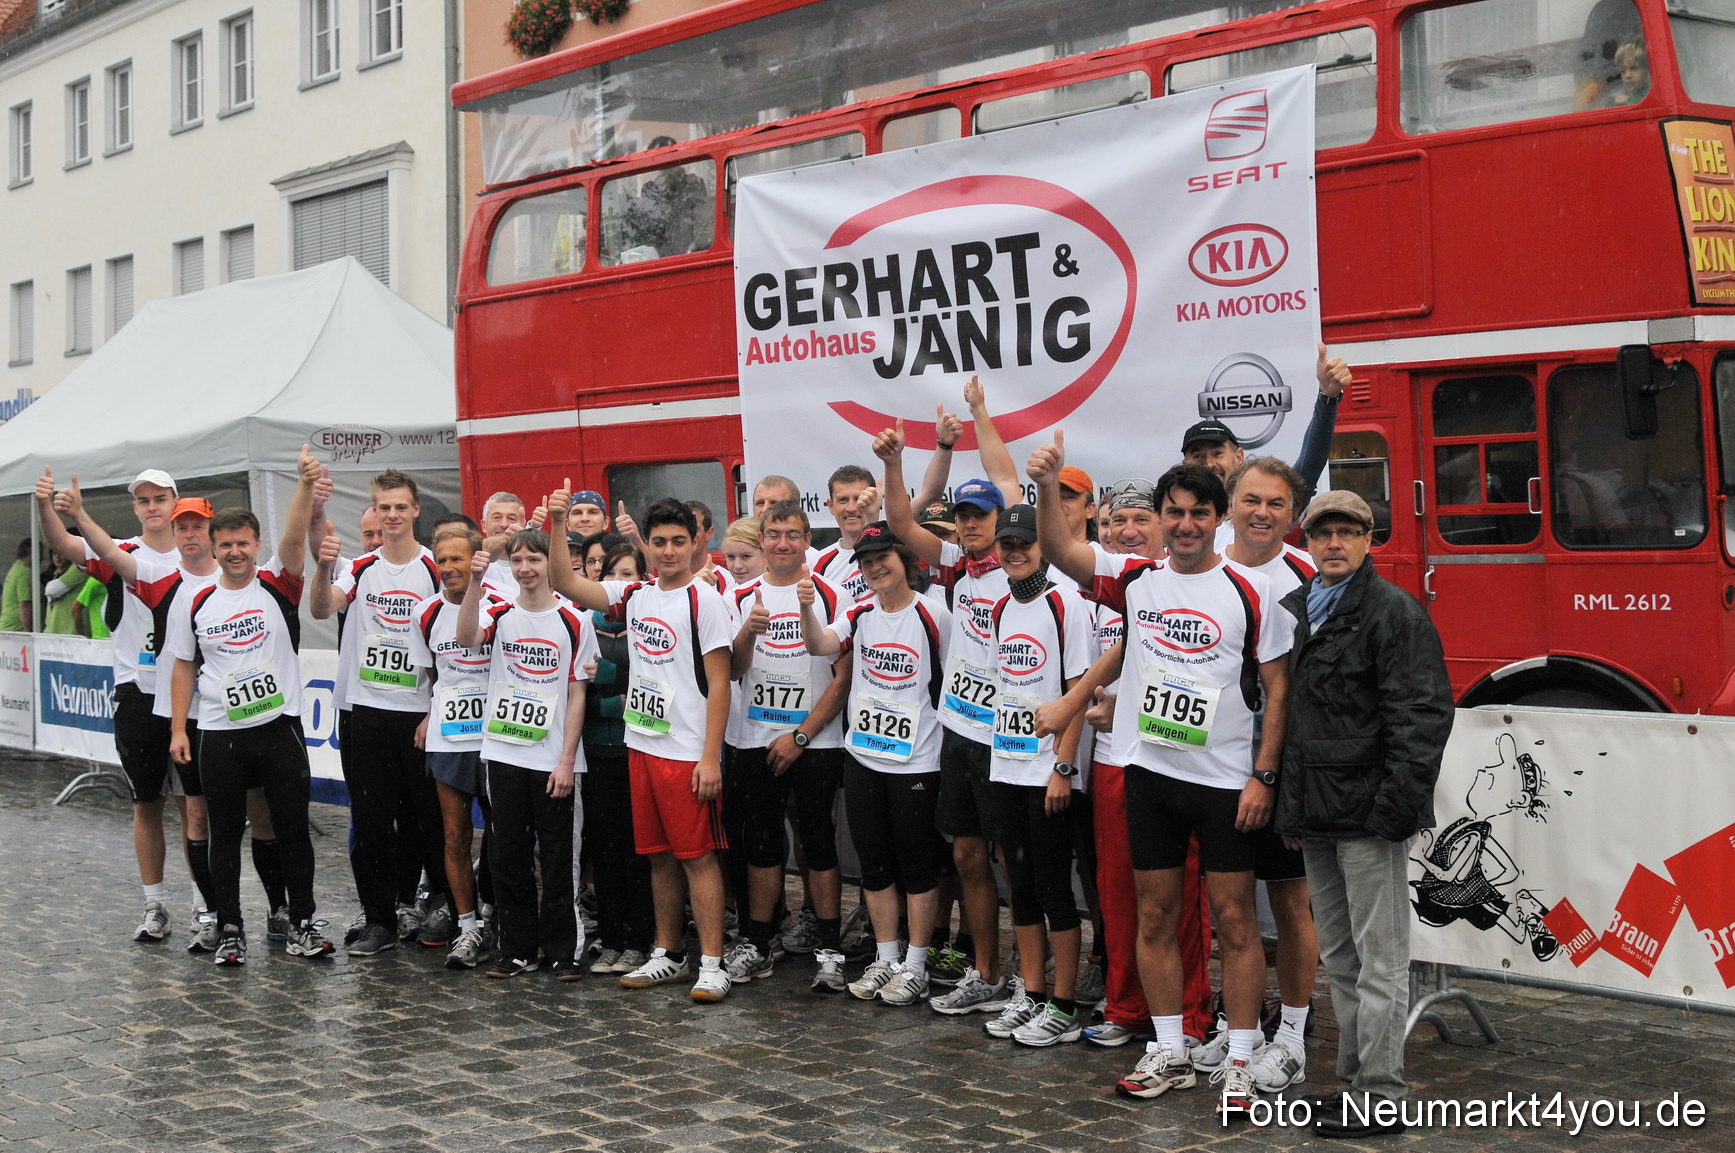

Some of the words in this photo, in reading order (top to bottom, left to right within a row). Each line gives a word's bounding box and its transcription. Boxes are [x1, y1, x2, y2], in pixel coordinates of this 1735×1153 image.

[1684, 138, 1728, 174] THE
[1187, 161, 1287, 193] SEAT
[1206, 236, 1272, 274] KIA
[743, 231, 1041, 331] GERHART
[1052, 243, 1080, 277] &
[1176, 301, 1211, 323] KIA
[1217, 290, 1306, 318] MOTORS
[745, 328, 877, 366] Autohaus
[872, 296, 1092, 380] JÄNIG
[1206, 391, 1284, 411] NISSAN
[322, 432, 382, 446] EICHNER
[399, 430, 458, 446] www.12
[366, 593, 413, 608] GERHART
[1573, 594, 1620, 611] RML
[1624, 594, 1672, 611] 2612
[207, 616, 258, 635] GERHART
[1136, 620, 1166, 632] Autohaus
[1137, 609, 1202, 632] GERHART
[1141, 638, 1153, 652] Das
[1186, 653, 1220, 665] Autohaus
[226, 674, 277, 707] 5168
[373, 671, 401, 684] Patrick
[951, 672, 997, 708] 3272
[242, 701, 273, 717] Torsten
[630, 687, 665, 719] 5145
[754, 683, 805, 709] 3177
[1143, 685, 1208, 727] 5195
[445, 698, 488, 721] 320
[496, 698, 548, 727] 5198
[763, 711, 791, 722] Rainer
[501, 724, 534, 739] Andreas
[858, 709, 912, 739] 3126
[1145, 720, 1188, 741] Jewgeni
[866, 737, 897, 751] Tamara
[1561, 929, 1593, 958] Braun
[1604, 910, 1659, 958] Braun
